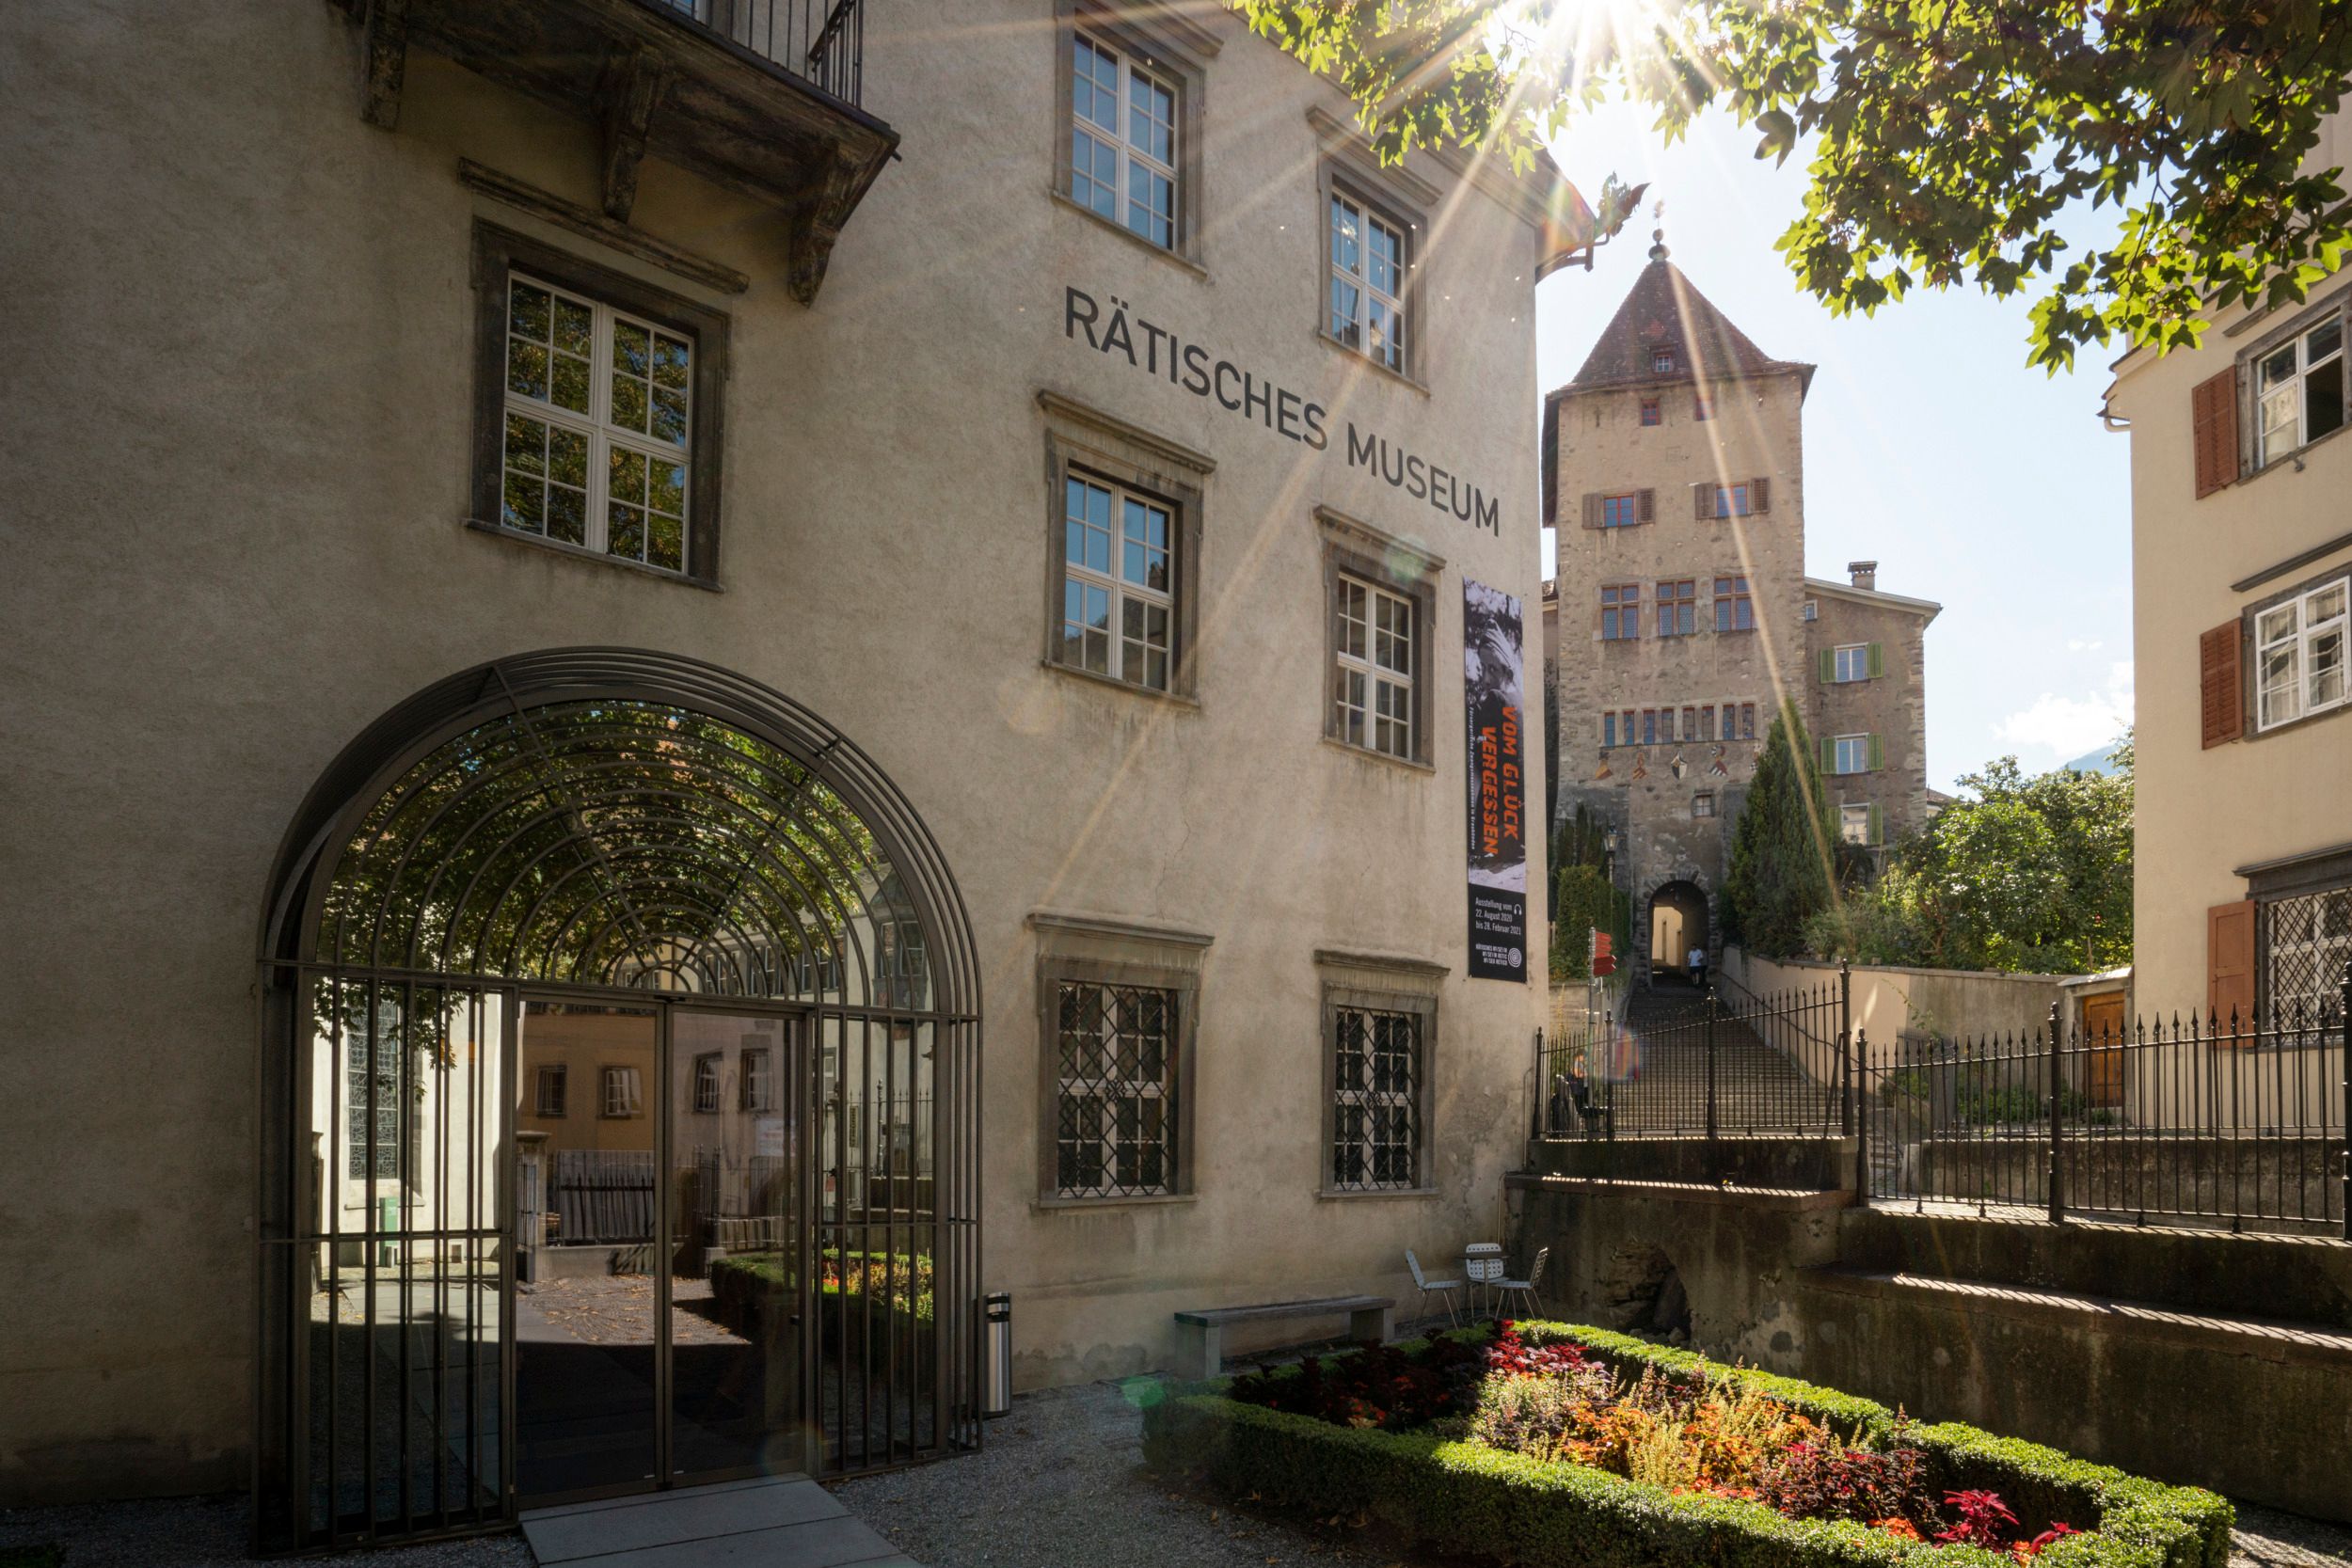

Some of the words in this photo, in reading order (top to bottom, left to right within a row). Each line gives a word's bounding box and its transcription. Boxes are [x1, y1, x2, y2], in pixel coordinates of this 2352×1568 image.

[1065, 285, 1327, 451] RÄTISCHES
[1347, 421, 1499, 538] MUSEUM
[1502, 707, 1517, 755] VOM
[1482, 727, 1498, 854] VERGESSEN
[1503, 763, 1520, 840] GLÜCK
[1476, 897, 1502, 911] Ausstellung
[1485, 911, 1500, 921] August
[1502, 912, 1512, 922] 2020
[1492, 923, 1509, 933] Februar
[1510, 926, 1520, 935] 2021
